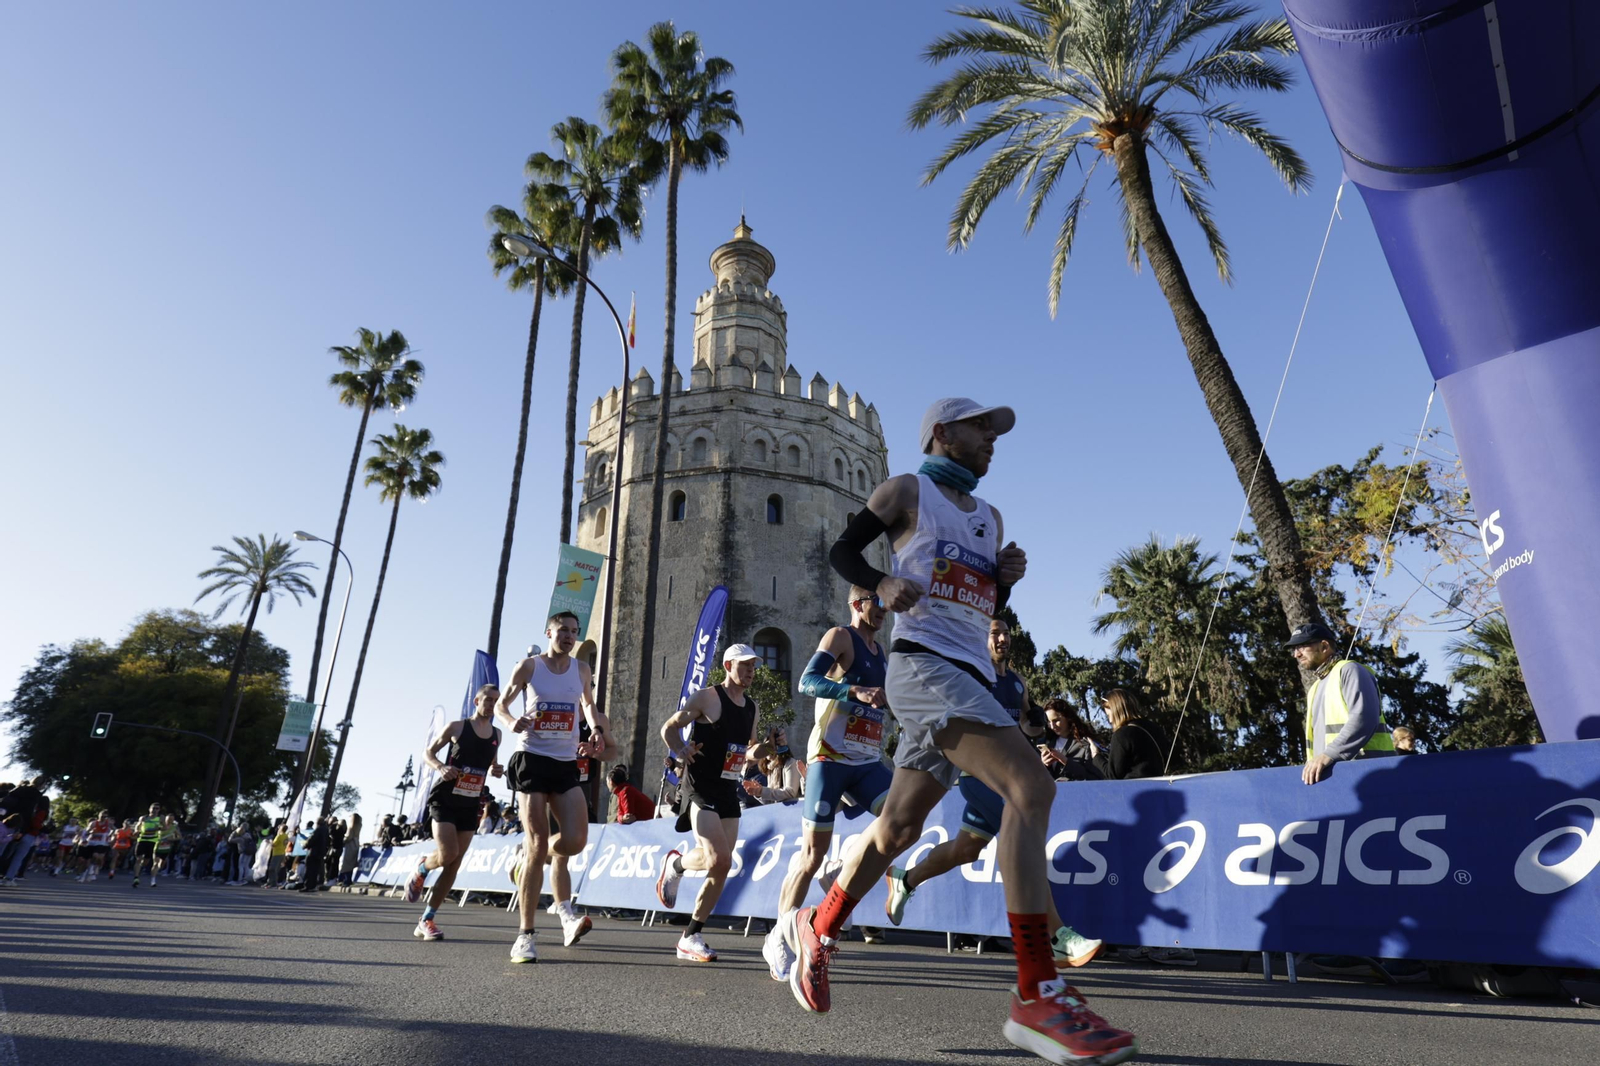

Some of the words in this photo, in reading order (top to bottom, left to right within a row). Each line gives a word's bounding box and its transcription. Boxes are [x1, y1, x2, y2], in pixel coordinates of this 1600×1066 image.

[561, 557, 574, 567] HAZ
[574, 560, 600, 573] MATCH
[963, 552, 993, 574] ZURICH
[1509, 549, 1534, 569] body
[554, 593, 566, 601] CON
[566, 595, 573, 603] LA
[573, 596, 591, 607] CASA
[930, 581, 954, 599] AM
[957, 587, 995, 616] GAZAPO
[561, 602, 570, 610] TU
[571, 604, 589, 614] VIDA
[540, 721, 569, 730] CASPER
[845, 732, 859, 741] JOSÉ
